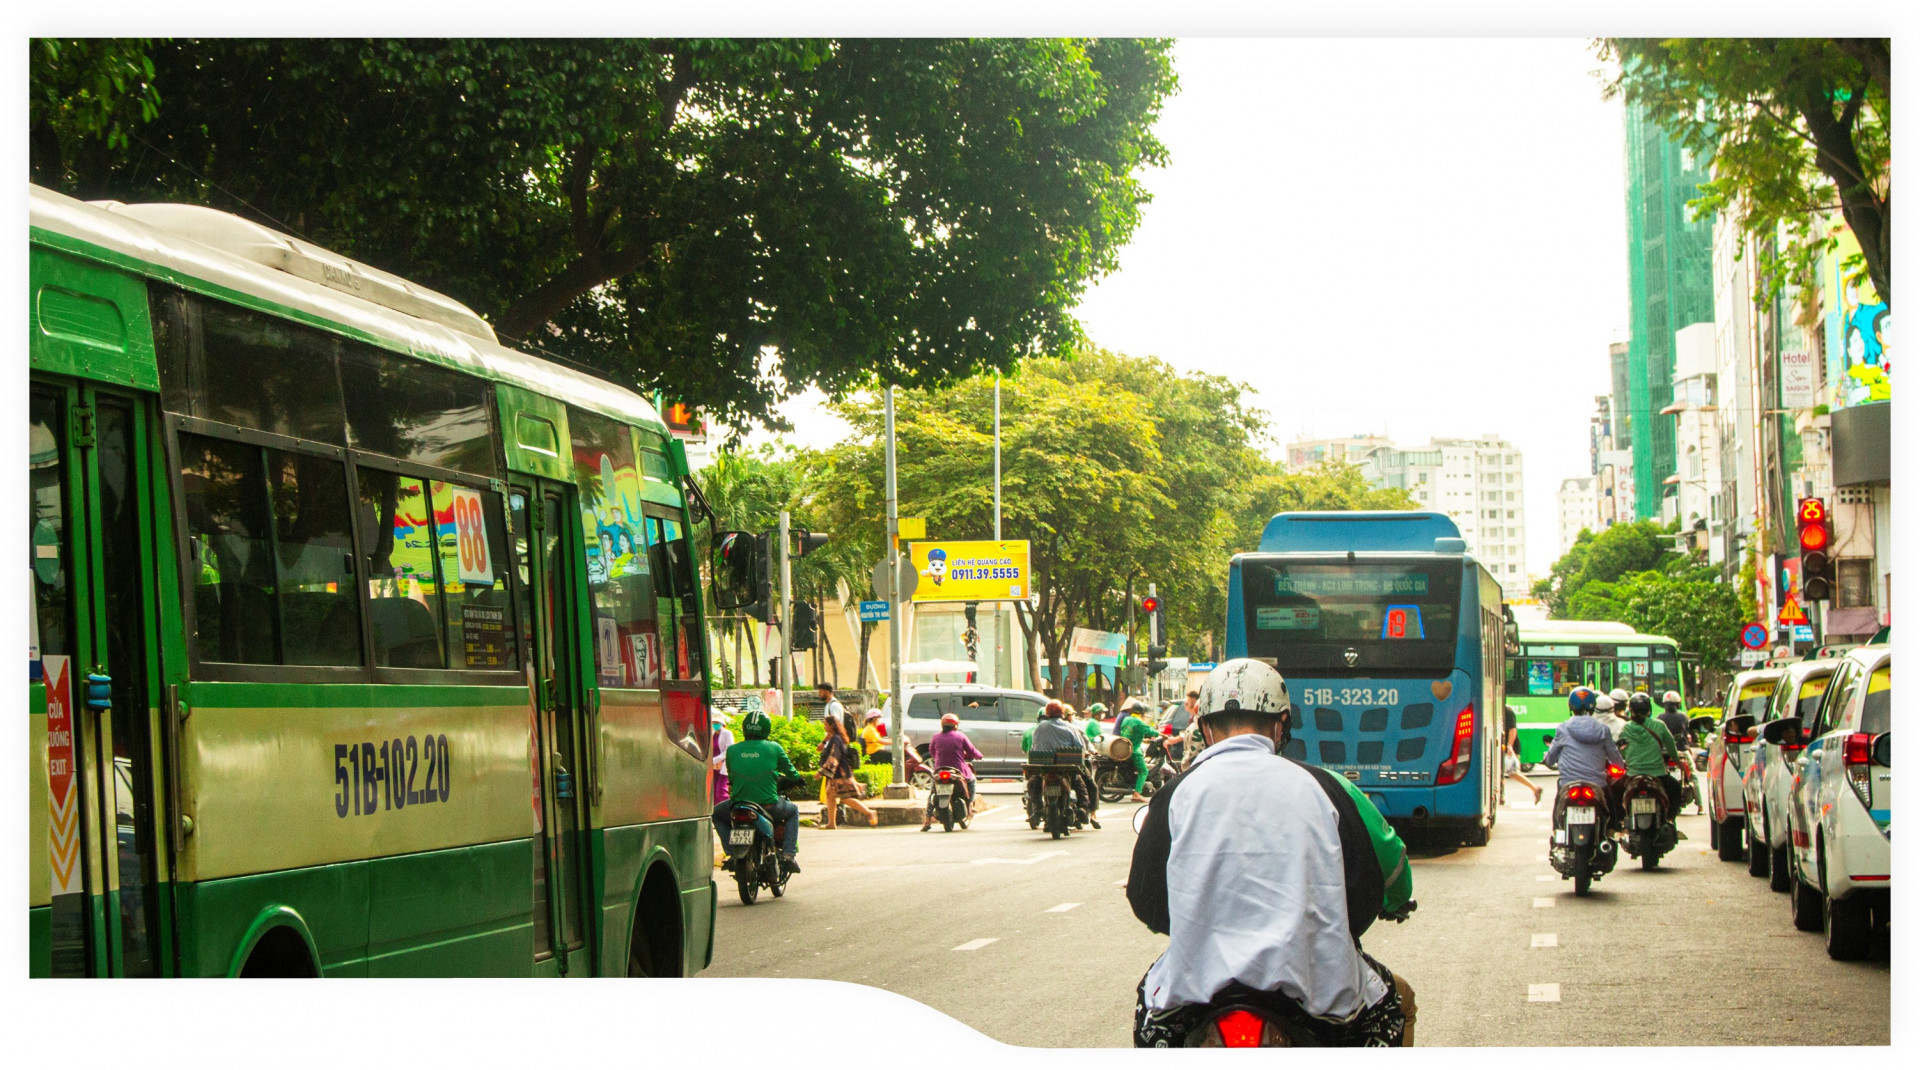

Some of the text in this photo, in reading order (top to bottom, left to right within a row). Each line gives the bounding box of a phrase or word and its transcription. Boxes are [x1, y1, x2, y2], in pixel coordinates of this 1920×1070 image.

[1783, 352, 1810, 363] Hotel
[1804, 502, 1820, 519] 25
[455, 495, 486, 573] 88
[952, 567, 1019, 580] 0911.39.5555
[1414, 579, 1426, 591] GIA
[1636, 663, 1645, 675] 72
[1304, 688, 1399, 706] 51B-323.20
[746, 723, 762, 731] Grab
[50, 759, 67, 776] EXIT
[335, 734, 450, 818] 51B-102.20
